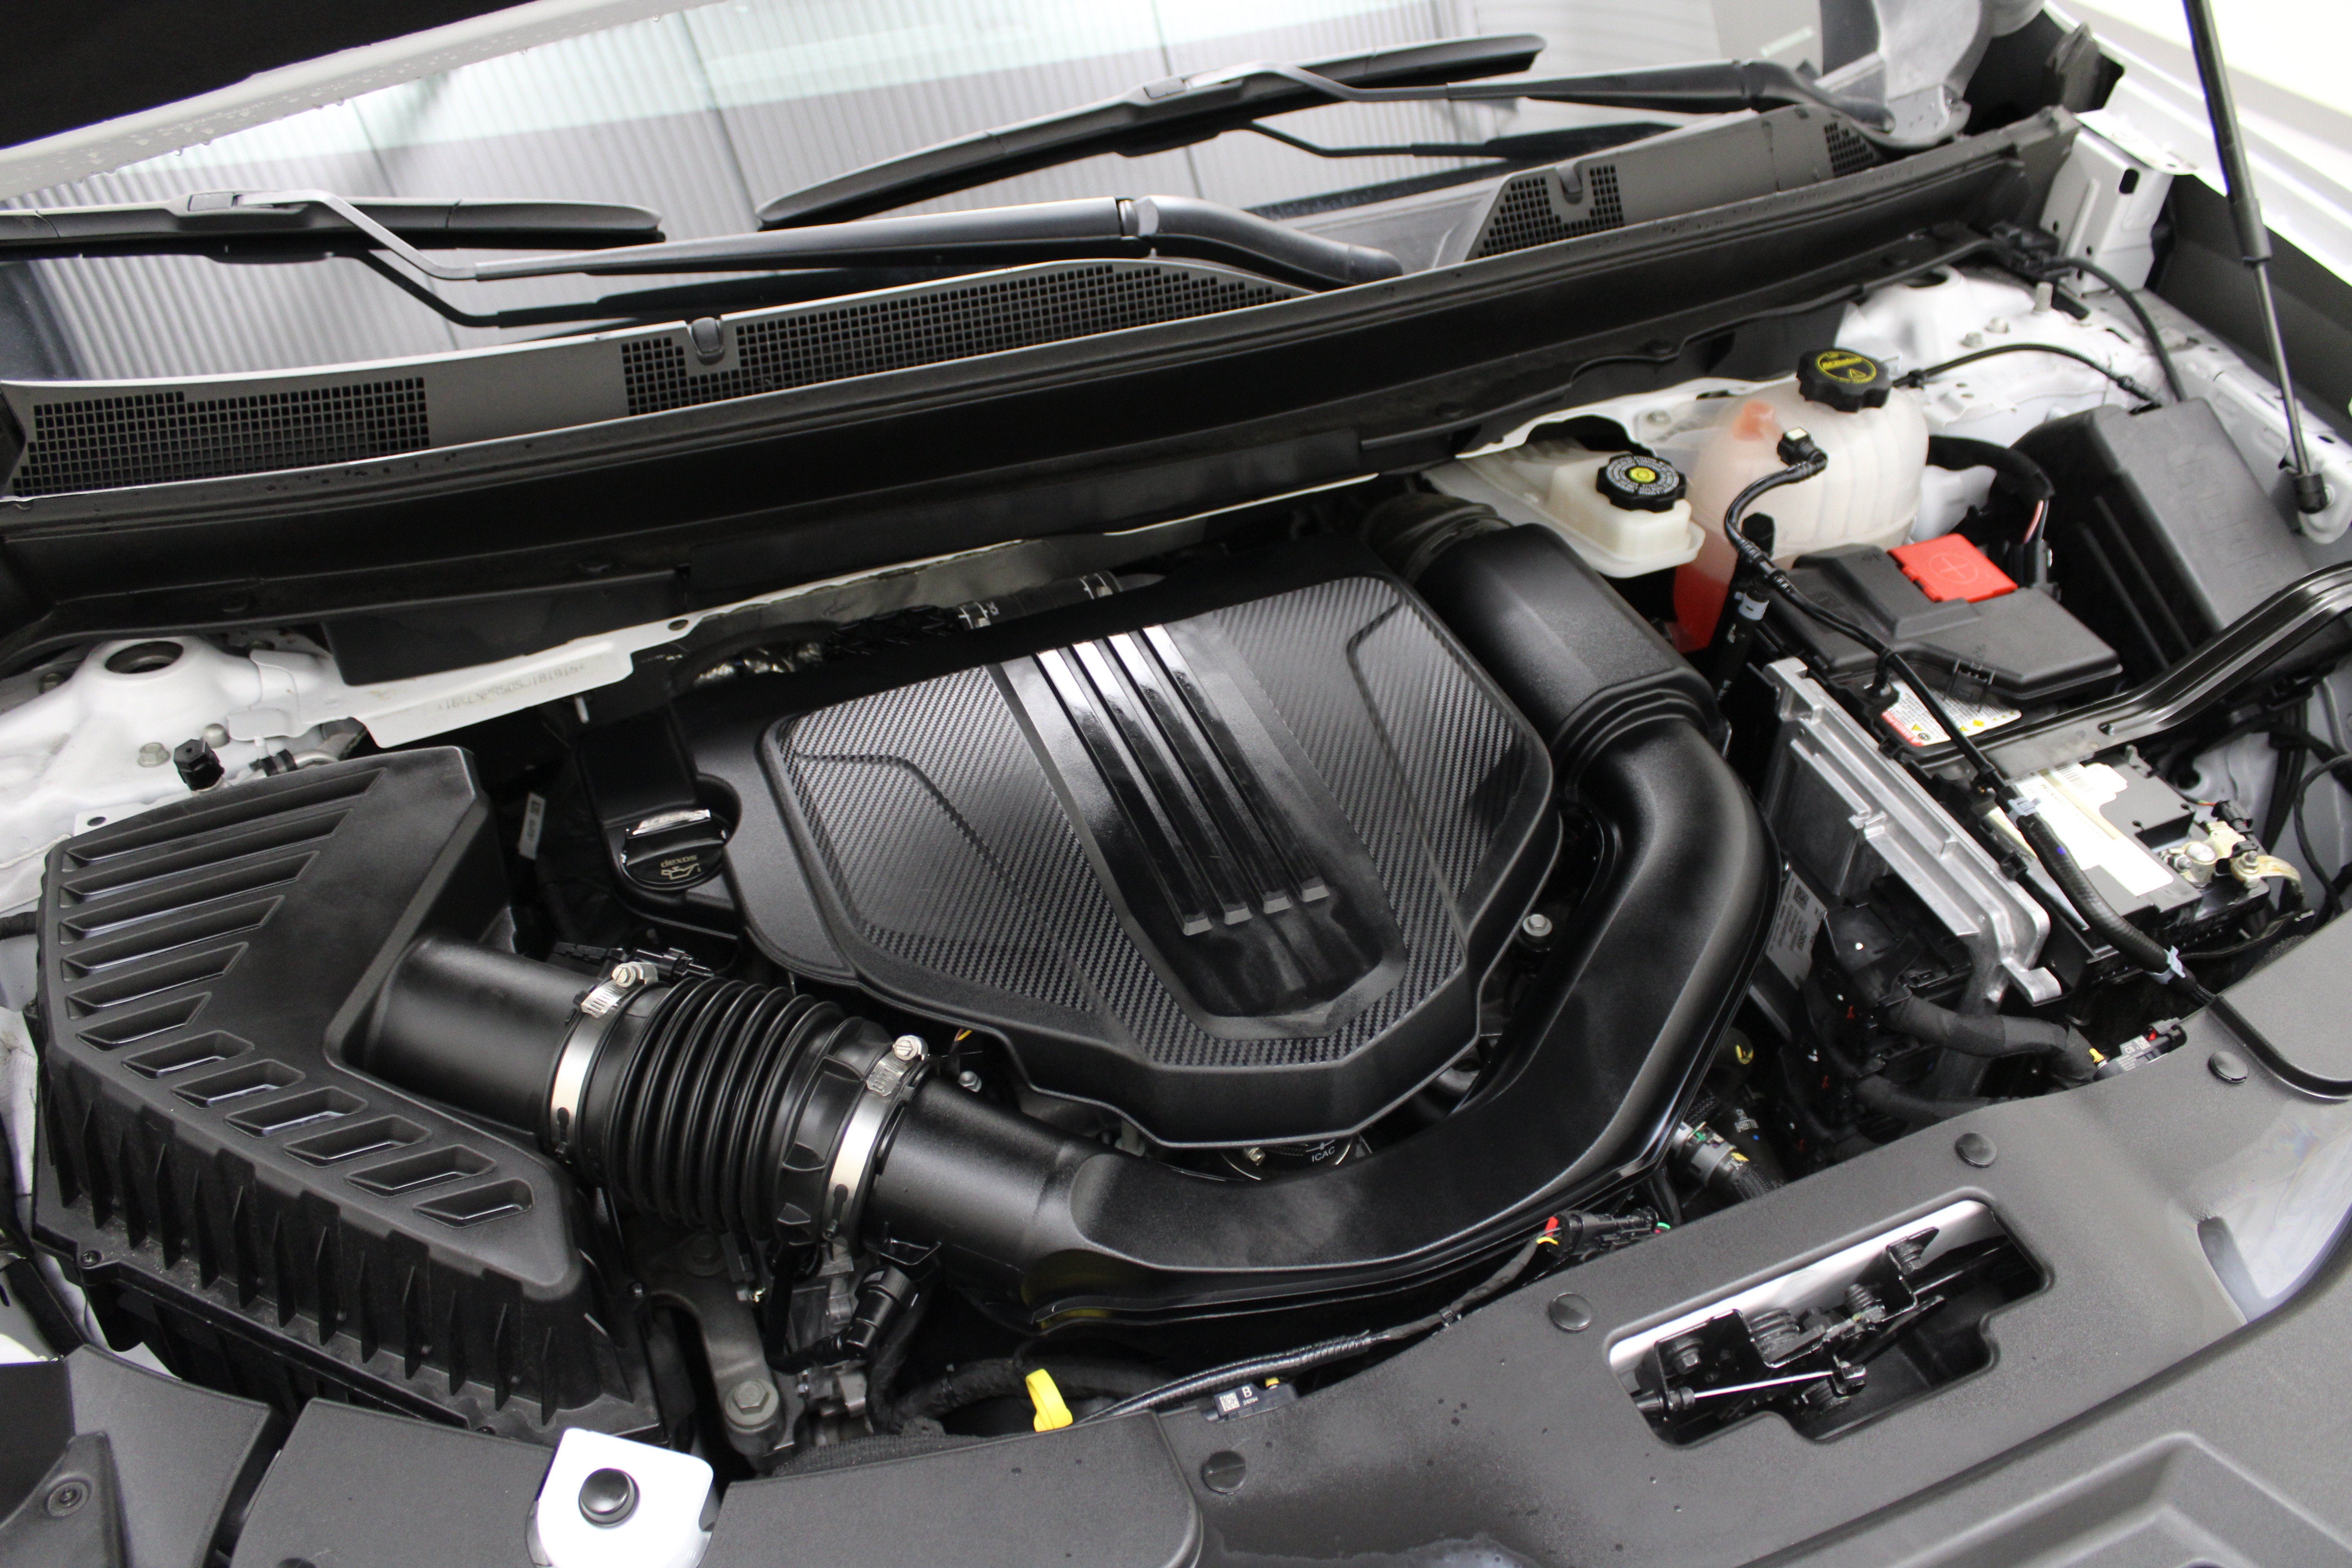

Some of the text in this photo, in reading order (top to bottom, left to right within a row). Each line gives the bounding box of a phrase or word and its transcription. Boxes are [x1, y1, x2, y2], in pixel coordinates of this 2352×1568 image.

[660, 855, 697, 868] dexos
[1312, 1146, 1335, 1162] ICAC
[1242, 1385, 1252, 1399] B
